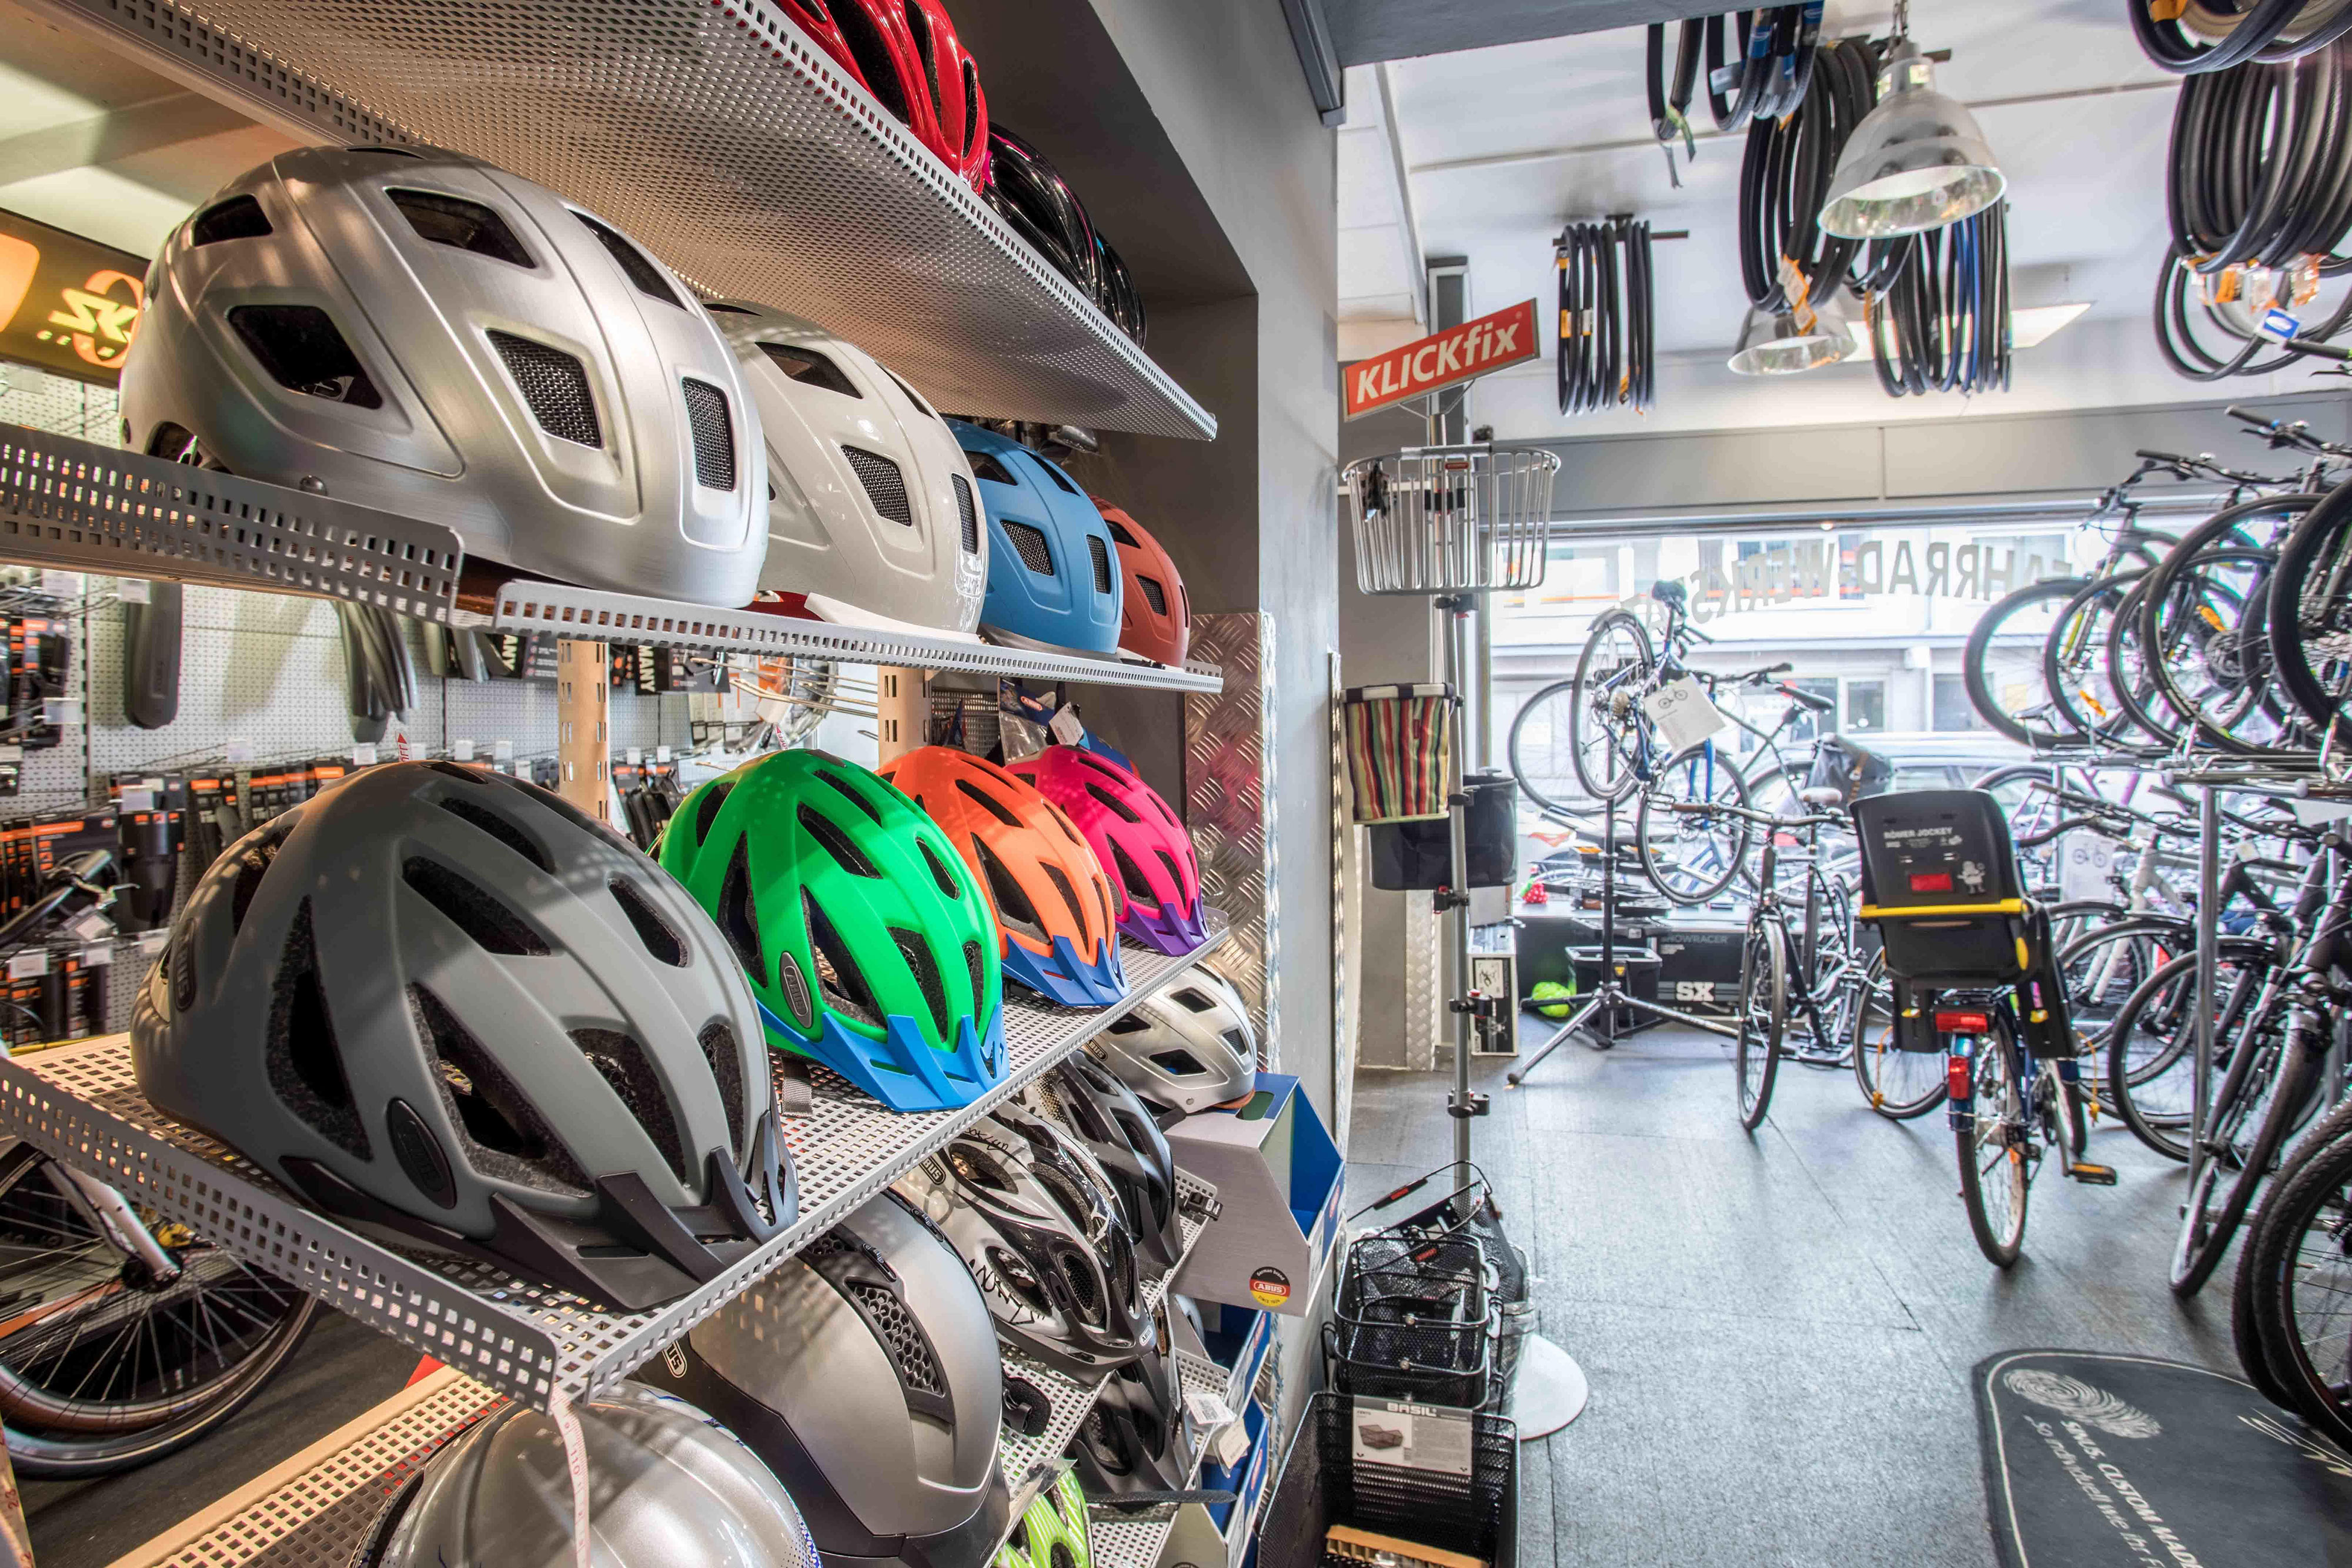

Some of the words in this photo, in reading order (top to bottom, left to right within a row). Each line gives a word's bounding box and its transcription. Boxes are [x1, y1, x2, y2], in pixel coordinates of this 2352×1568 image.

[1356, 322, 1520, 404] KLICKfix
[1917, 827, 1953, 837] JOCKEY
[786, 974, 804, 1011] ABUS
[1676, 981, 1715, 1002] SX
[1088, 1039, 1105, 1059] BUS
[922, 1157, 943, 1183] BUS
[1257, 1283, 1282, 1293] ABUS
[1387, 1401, 1431, 1417] BASIL
